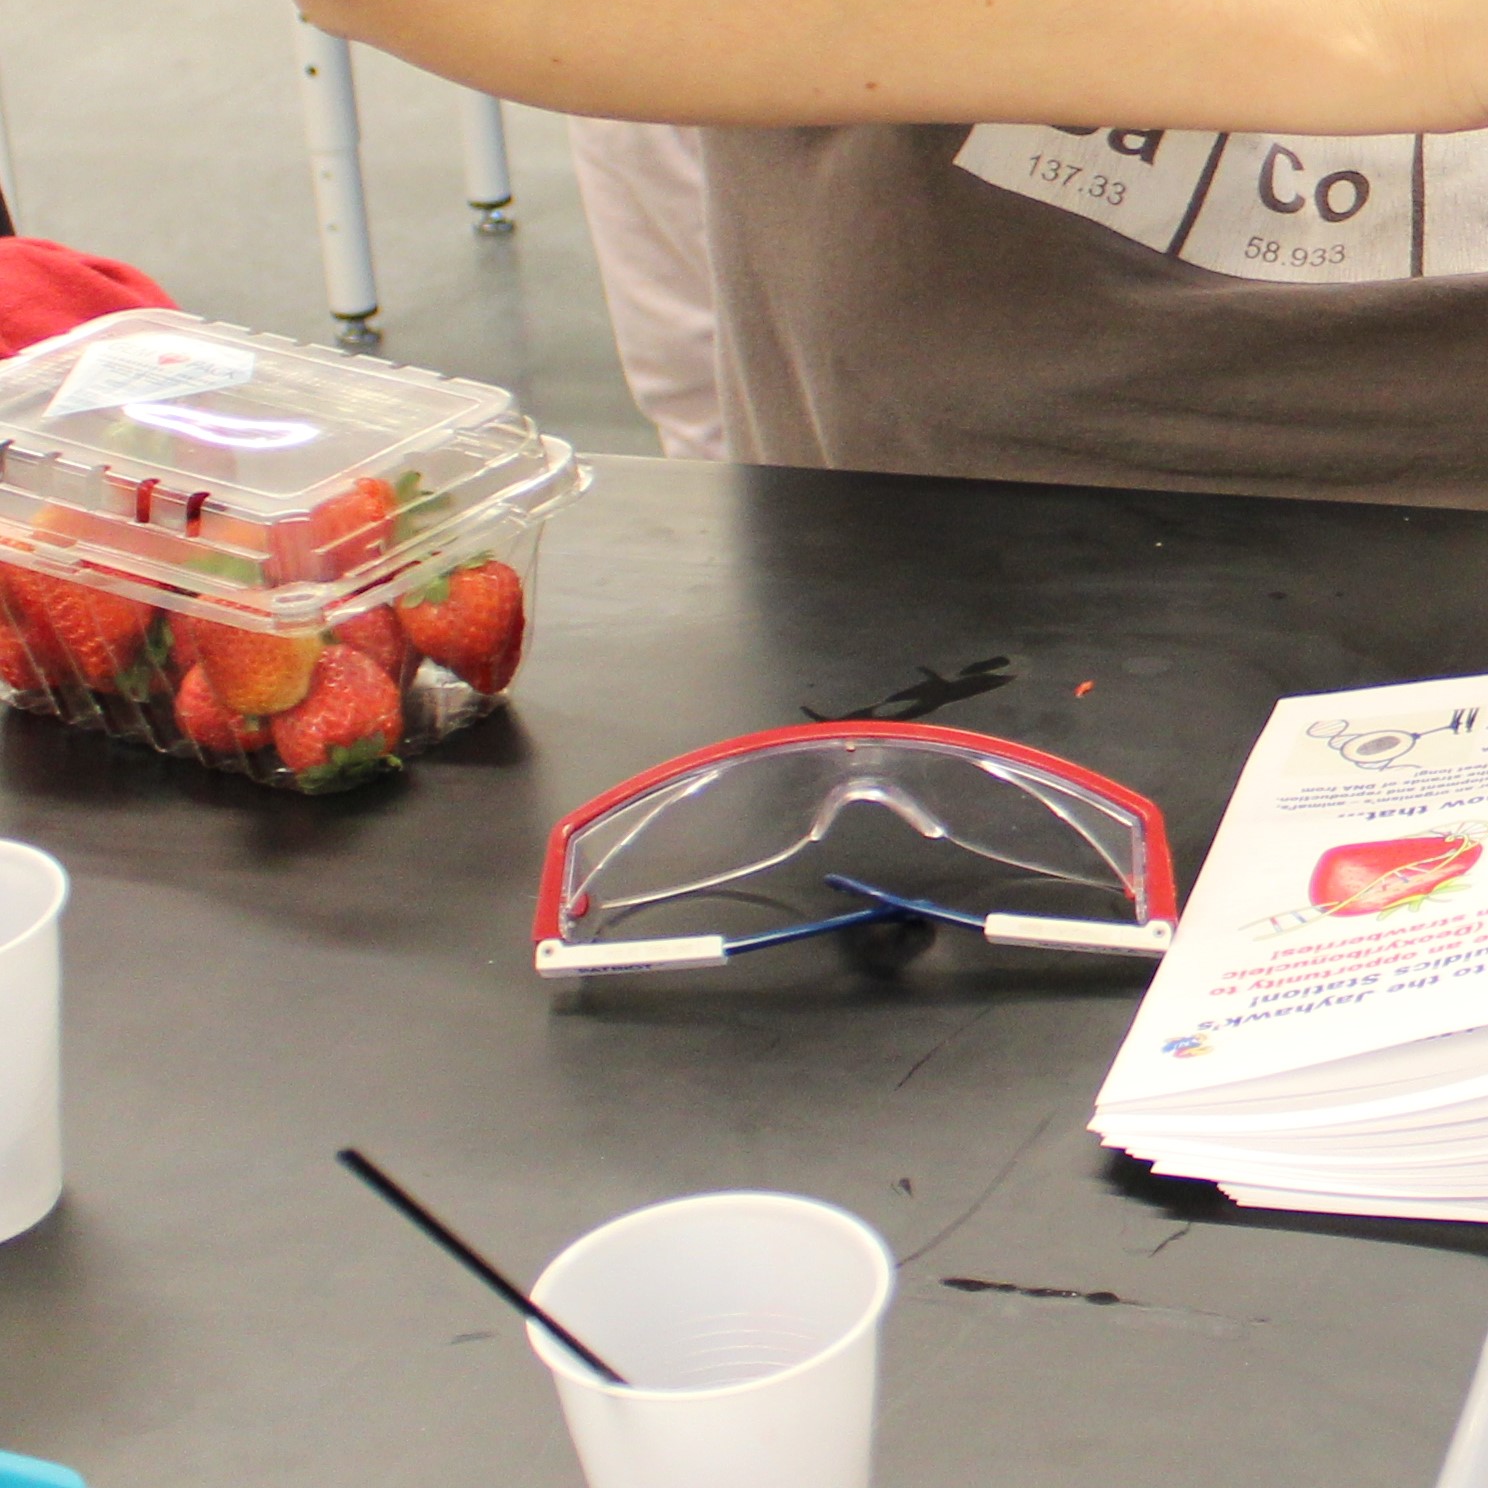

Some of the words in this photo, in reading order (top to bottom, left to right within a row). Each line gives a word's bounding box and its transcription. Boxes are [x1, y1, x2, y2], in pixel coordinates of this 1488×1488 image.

[1049, 125, 1166, 166] a
[1257, 142, 1370, 223] Co
[1027, 152, 1127, 206] 137.33
[1243, 234, 1347, 267] 58.933
[1221, 920, 1484, 979] (Deoxyribonucleic
[1270, 913, 1466, 961] strawberries!
[1427, 940, 1462, 954] an
[1247, 951, 1417, 990] opportunity
[1249, 972, 1381, 1007] Station!
[1386, 974, 1439, 992] the
[1452, 963, 1485, 977] to
[1208, 985, 1237, 995] to
[1192, 989, 1374, 1035] Jayhawk's
